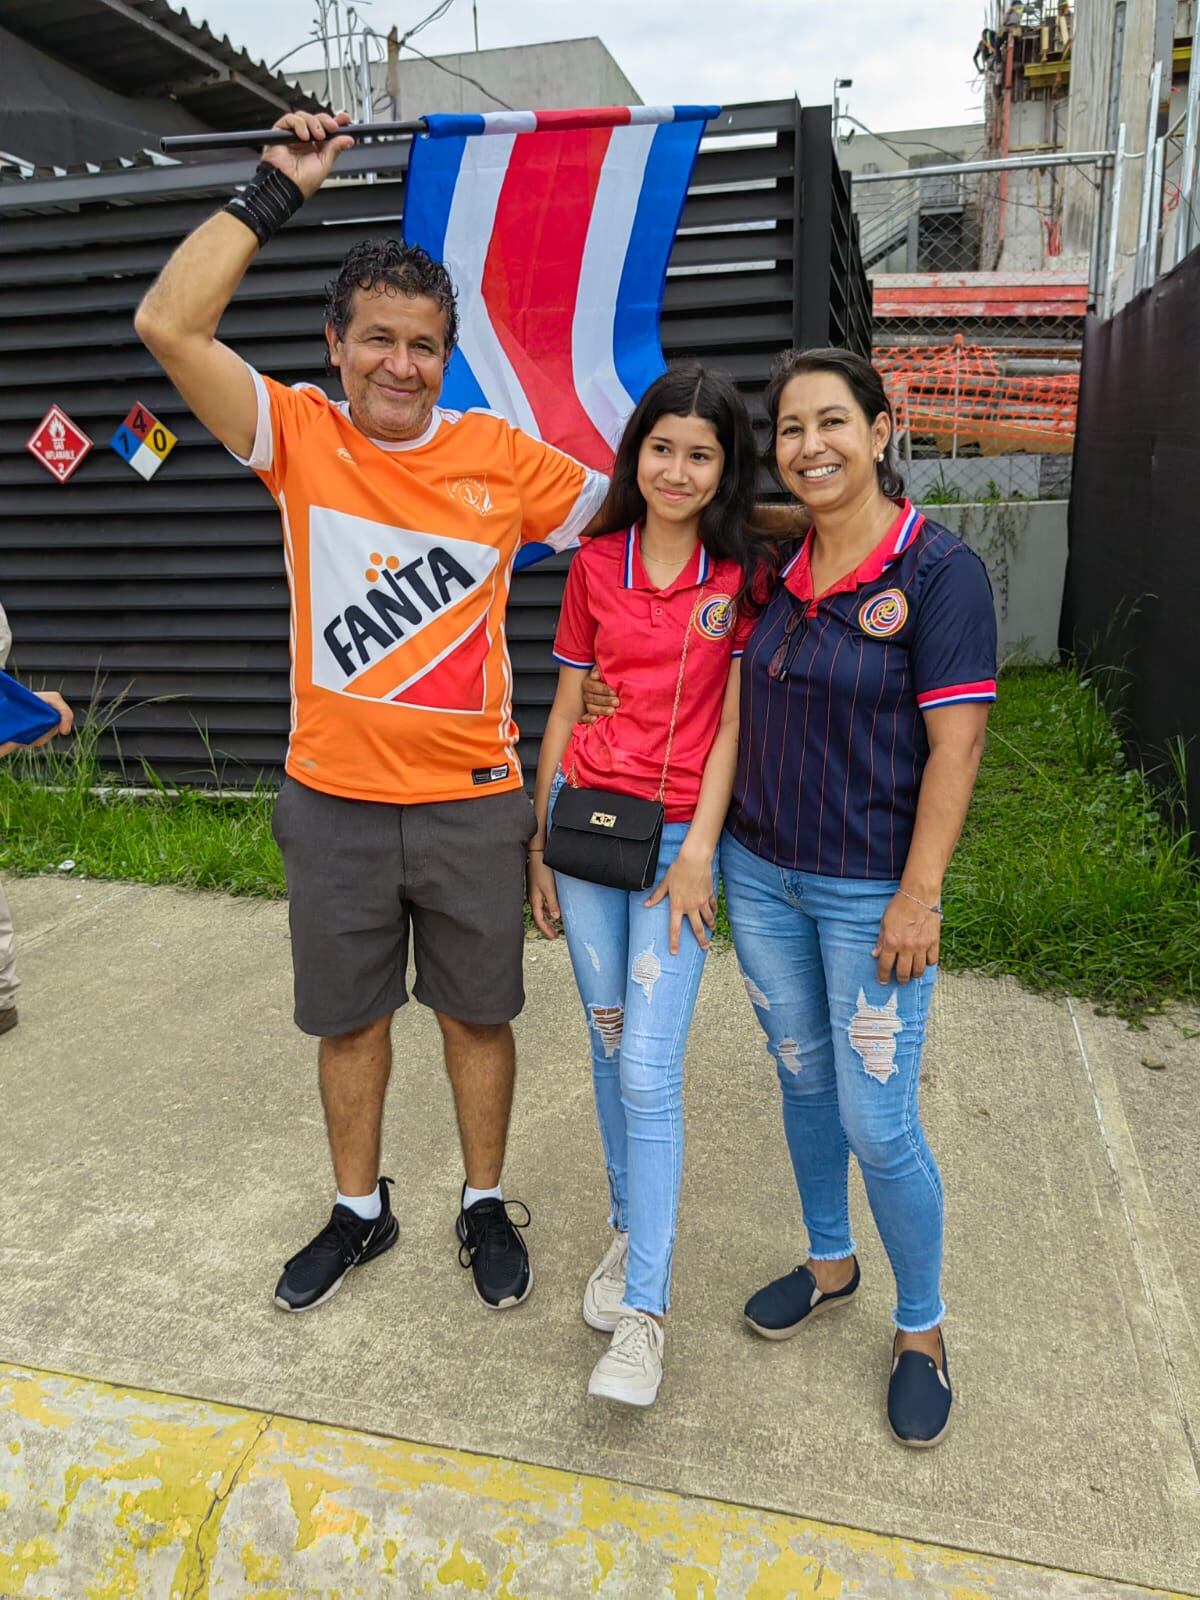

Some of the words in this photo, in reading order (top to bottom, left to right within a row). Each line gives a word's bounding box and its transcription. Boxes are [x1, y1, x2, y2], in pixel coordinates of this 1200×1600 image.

[133, 410, 147, 433] 4
[118, 431, 129, 454] 1
[153, 429, 167, 452] 0
[58, 463, 65, 473] 2
[323, 547, 477, 678] FANTA
